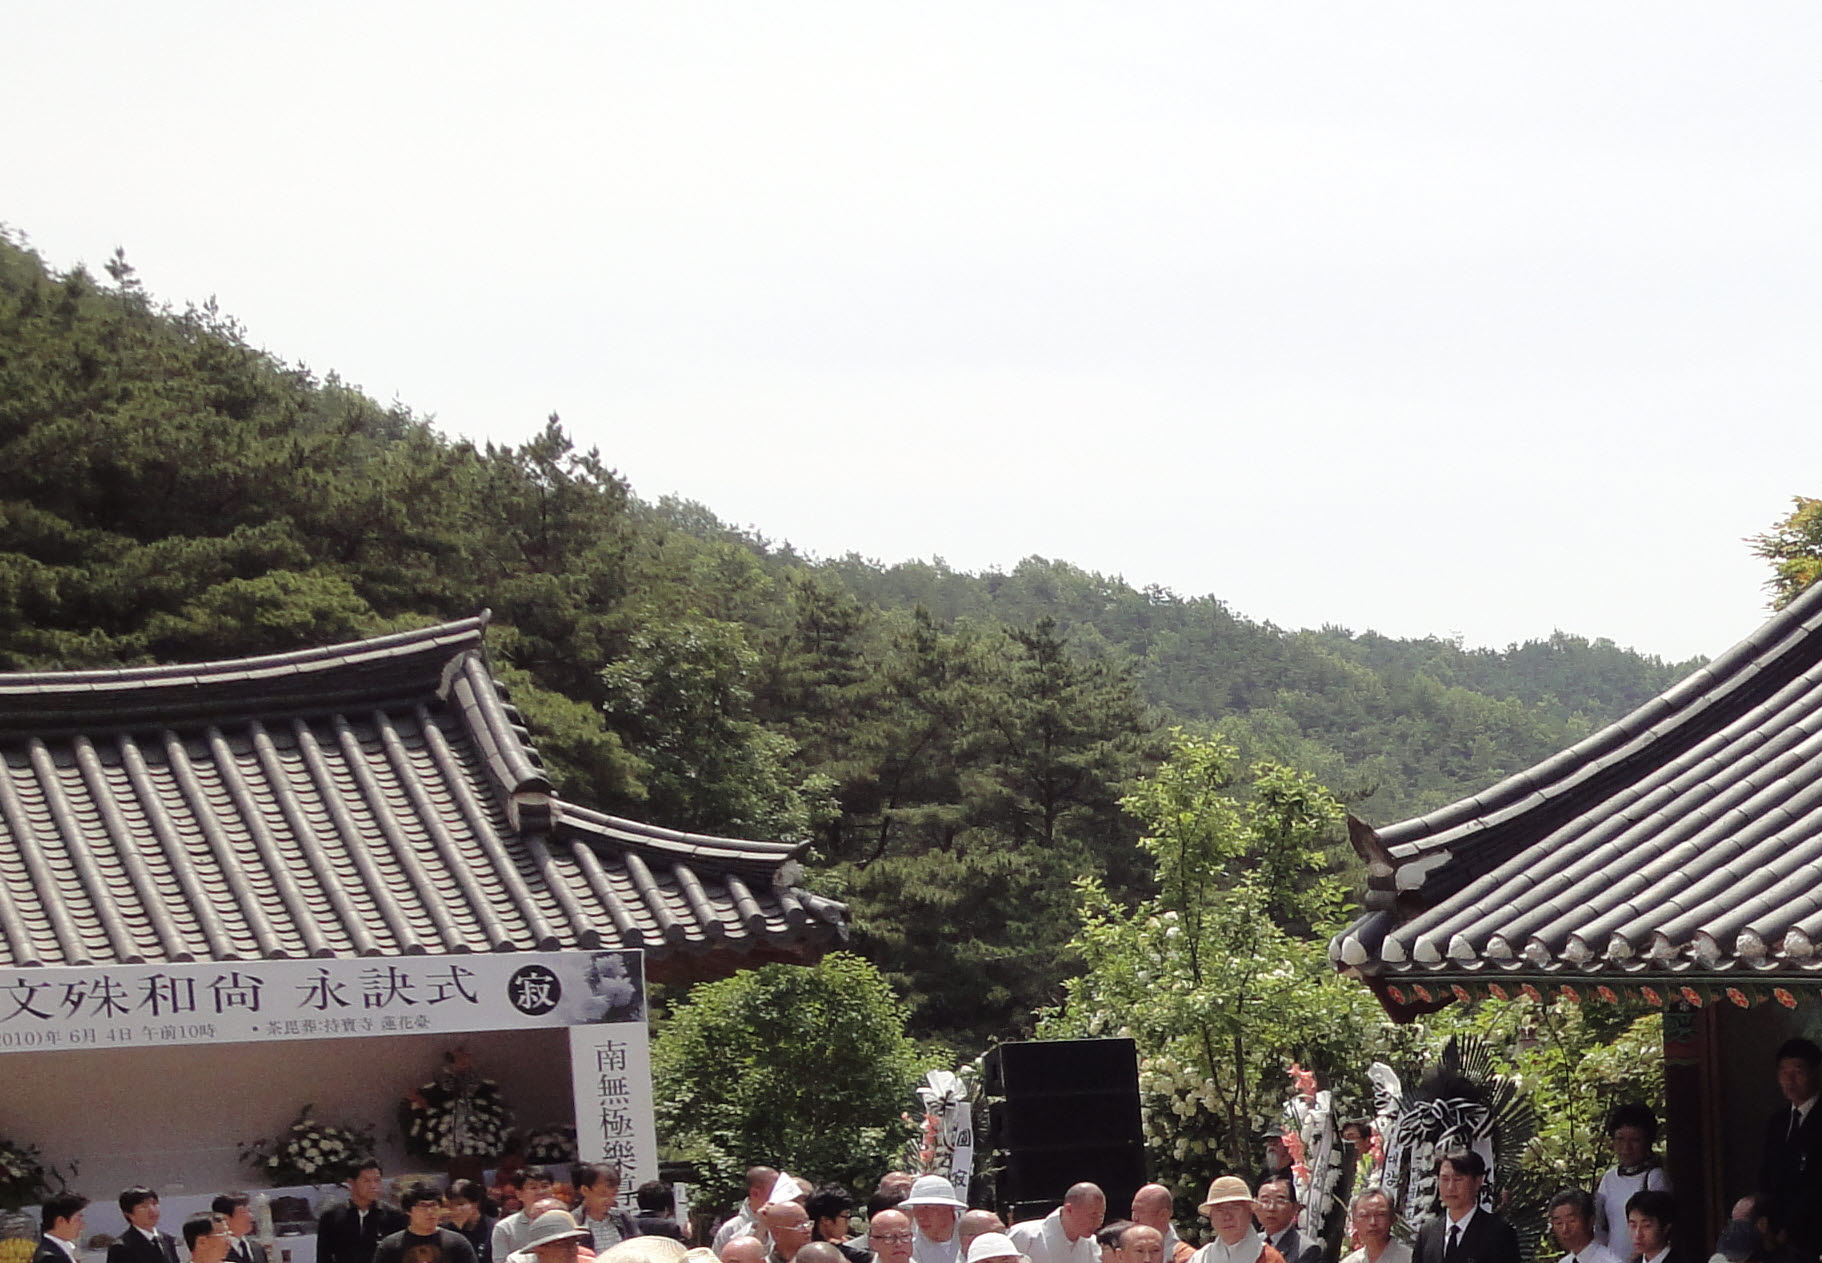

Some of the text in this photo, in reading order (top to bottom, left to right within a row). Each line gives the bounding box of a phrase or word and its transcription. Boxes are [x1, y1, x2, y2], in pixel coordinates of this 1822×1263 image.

[296, 965, 478, 1010] 永訣式
[0, 1030, 61, 1046] 010)年
[69, 1028, 96, 1043] 6月
[106, 1027, 132, 1041] 4日
